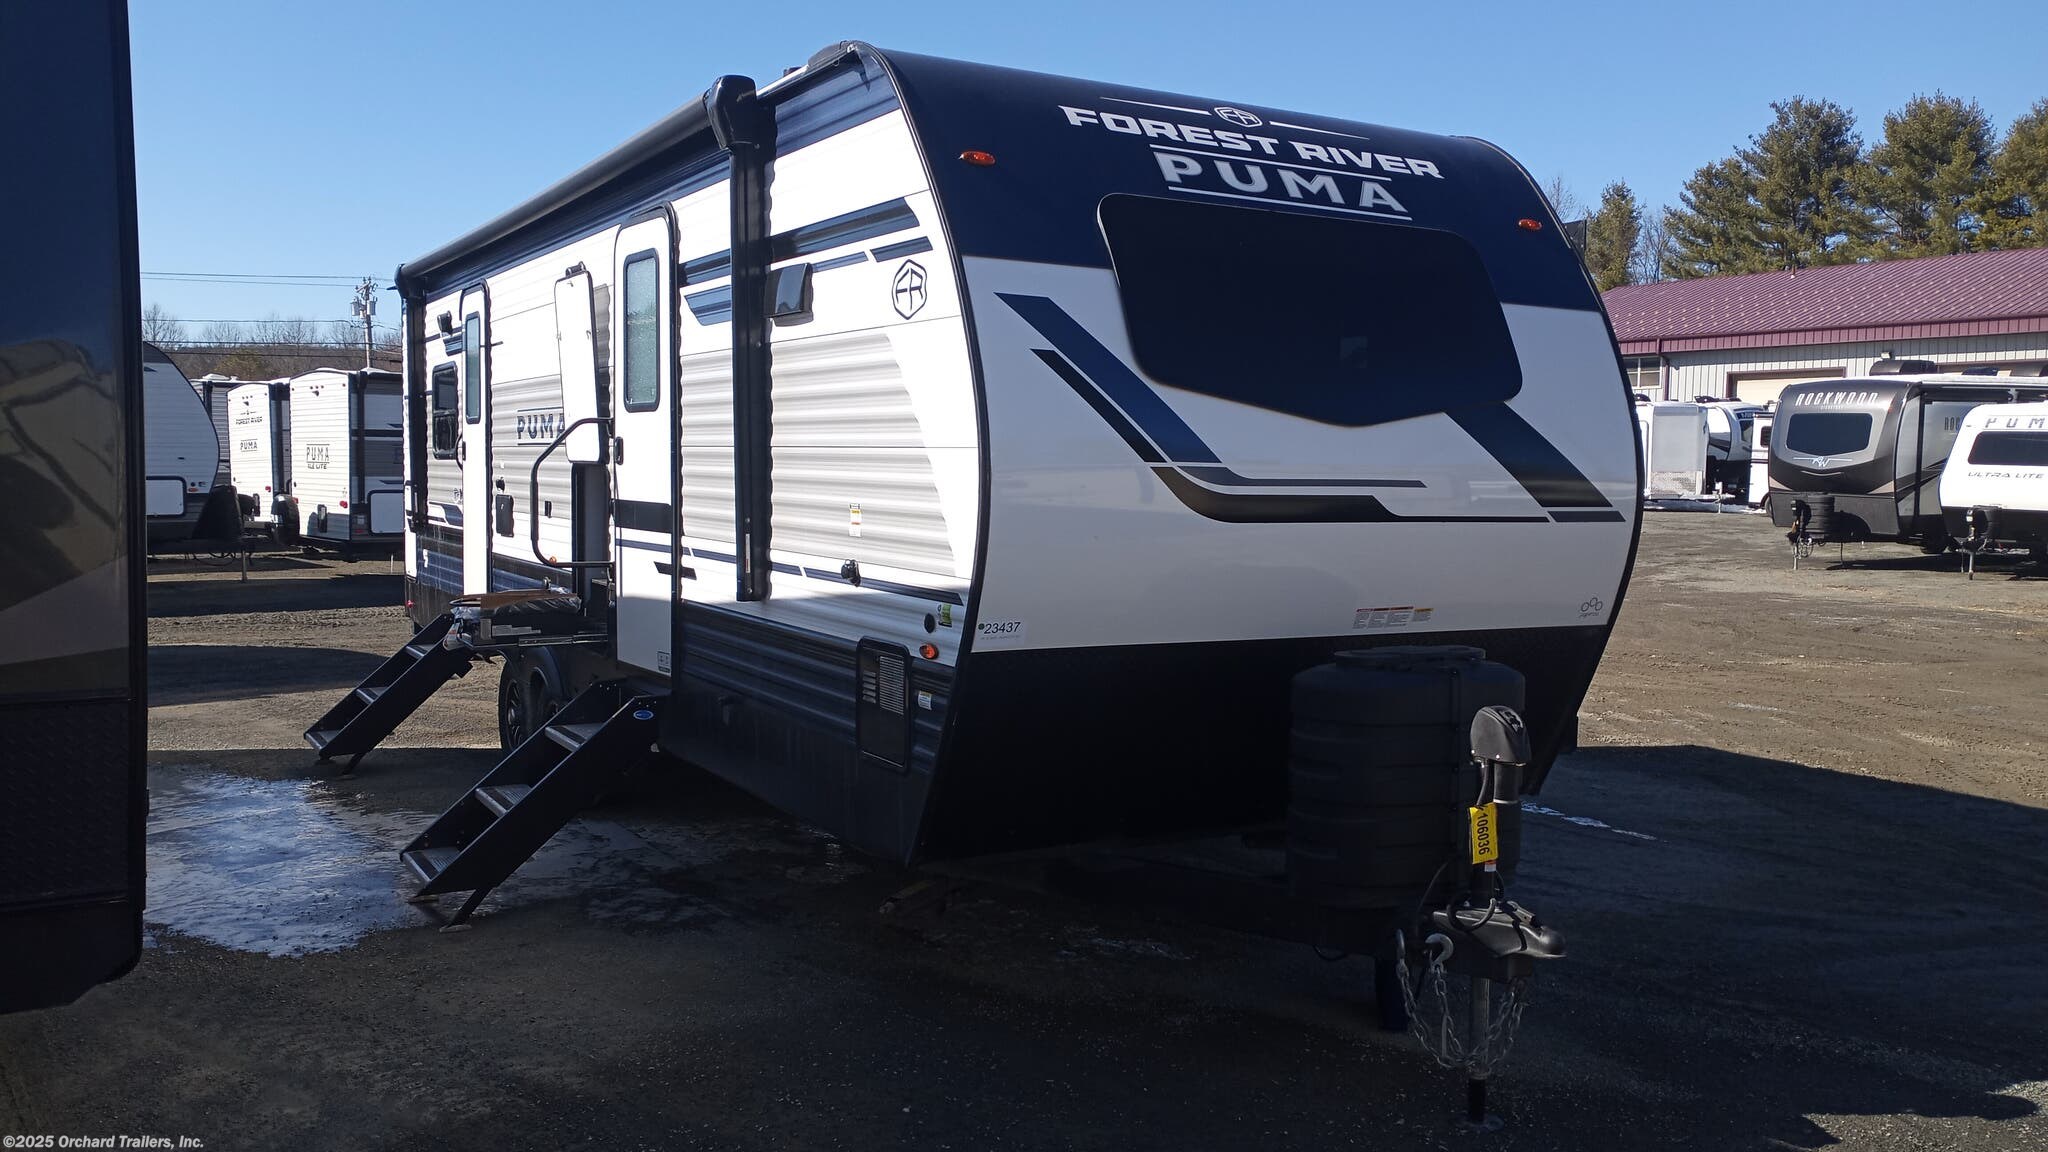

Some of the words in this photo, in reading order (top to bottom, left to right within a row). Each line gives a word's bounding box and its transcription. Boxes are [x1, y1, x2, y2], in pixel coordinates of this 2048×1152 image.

[1057, 105, 1279, 155] FOREST
[1287, 141, 1445, 179] RIVER
[1153, 151, 1410, 213] PUMA
[1795, 391, 1878, 406] ROCKWOOD
[240, 441, 258, 450] PUMA
[306, 446, 329, 461] PUMA
[984, 621, 1021, 634] 23437
[1477, 814, 1489, 855] 106036
